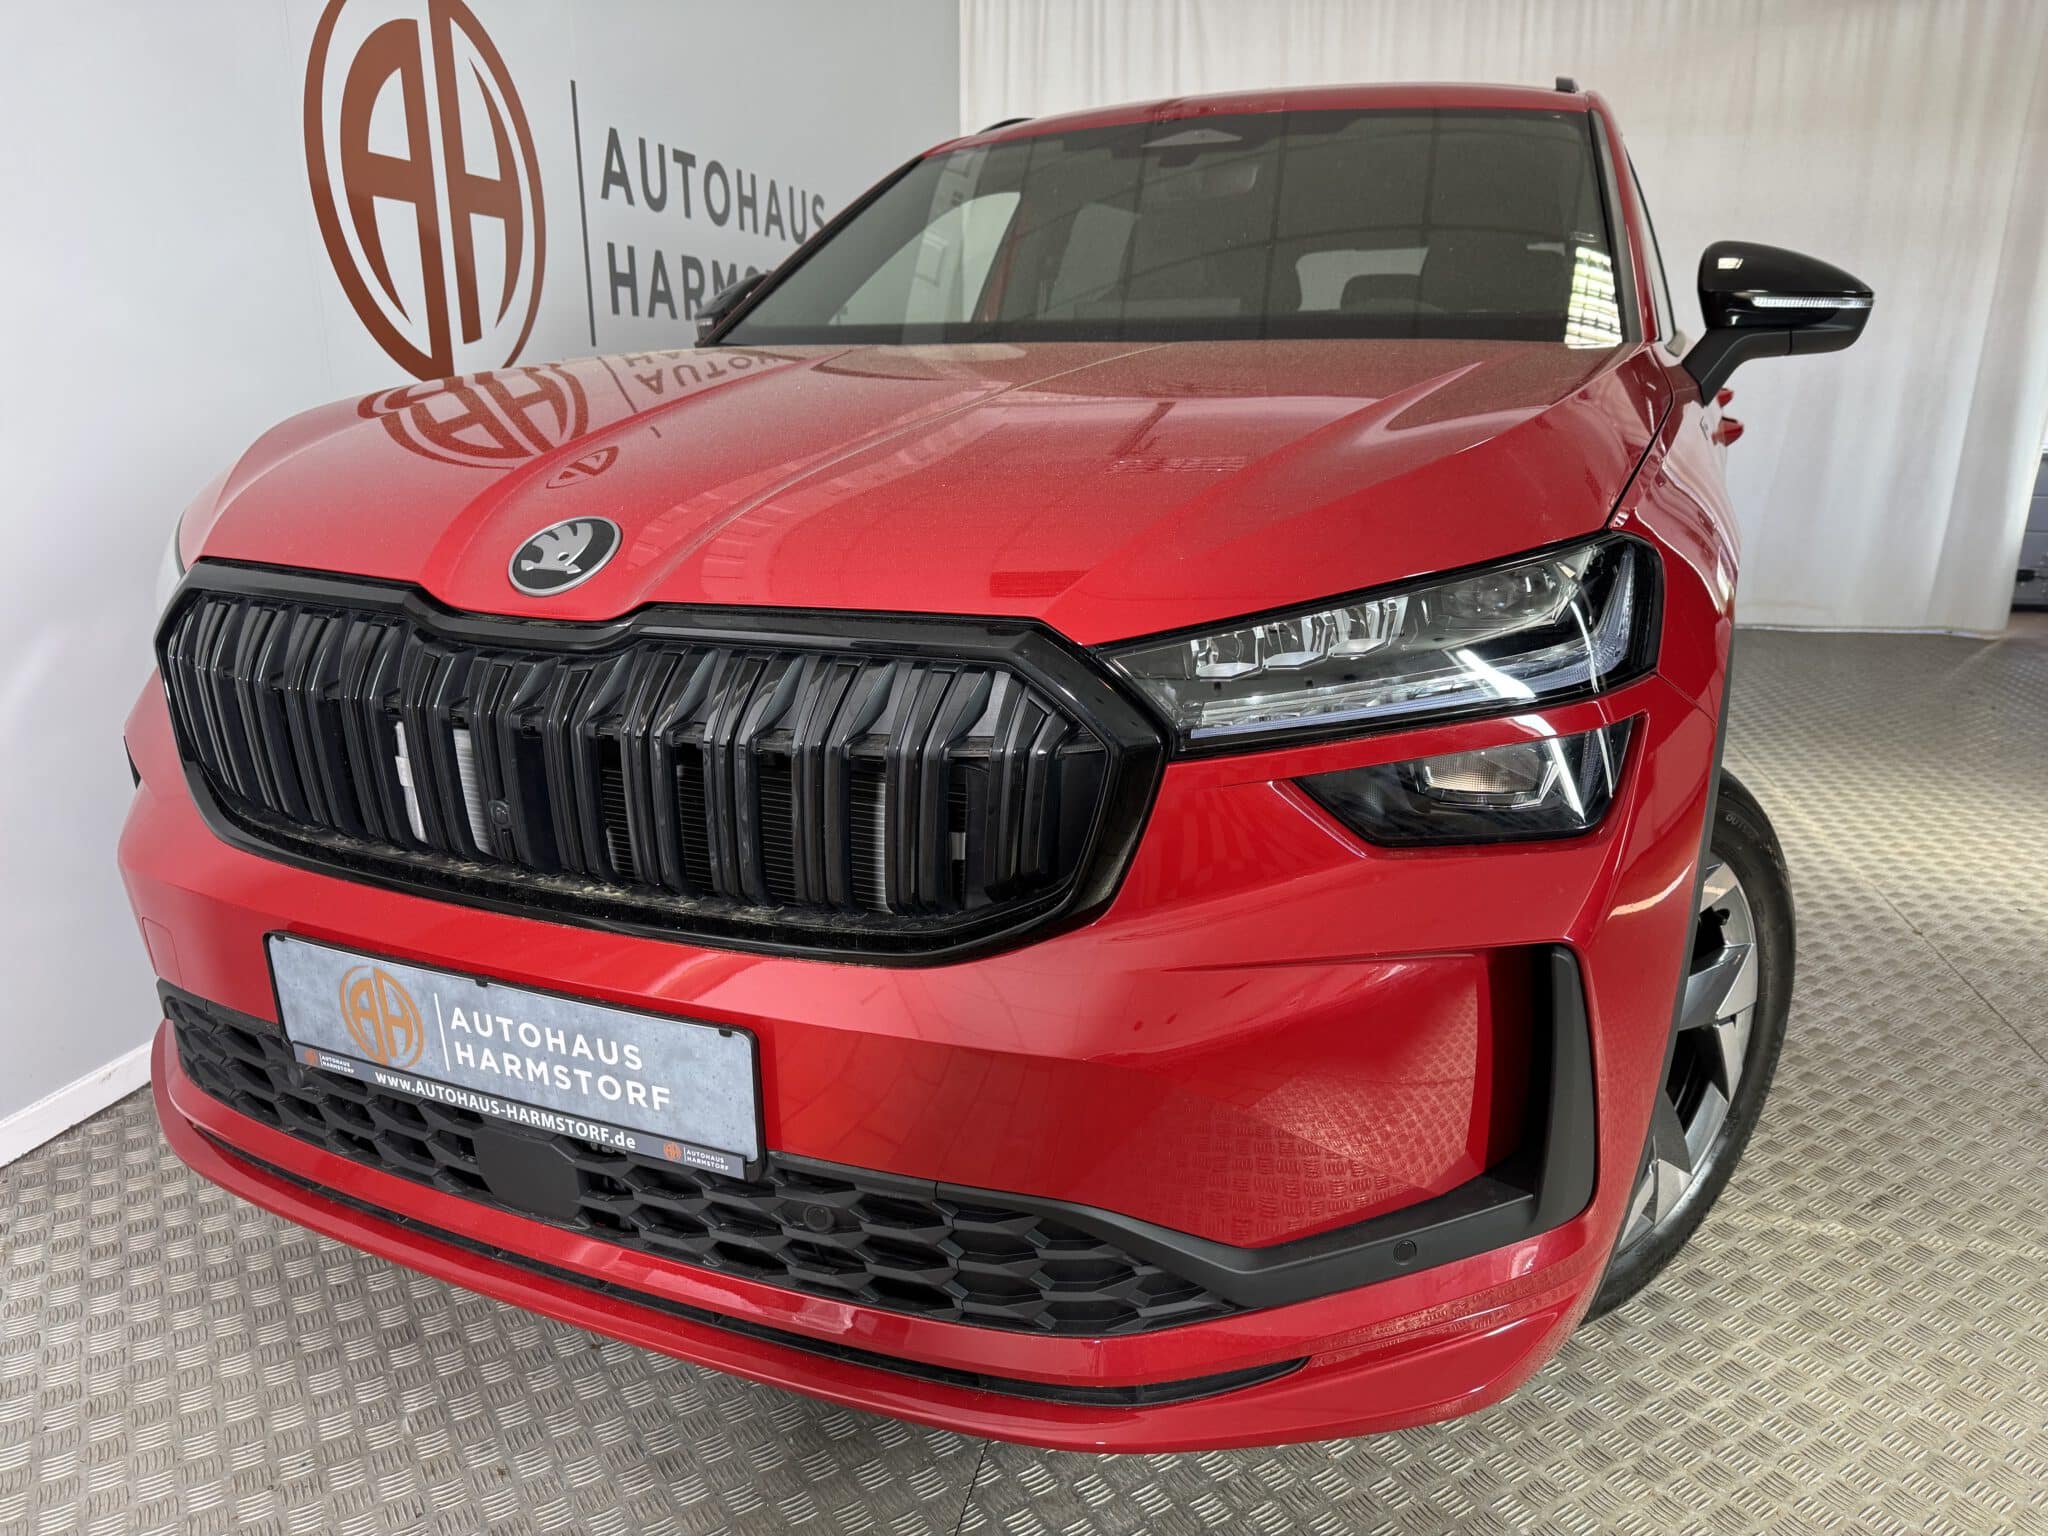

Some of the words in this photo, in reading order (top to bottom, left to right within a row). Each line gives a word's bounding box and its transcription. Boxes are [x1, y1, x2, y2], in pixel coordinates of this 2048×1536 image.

[600, 126, 825, 245] AUTOHAUS
[451, 1007, 643, 1071] AUTOHAUS
[454, 1041, 671, 1111] HARMSTORF
[375, 1072, 636, 1149] www.AUTOHAUS-HARMSTORF.de
[686, 1149, 725, 1163] AUTOHAUS
[686, 1156, 729, 1171] HARMSTORF
